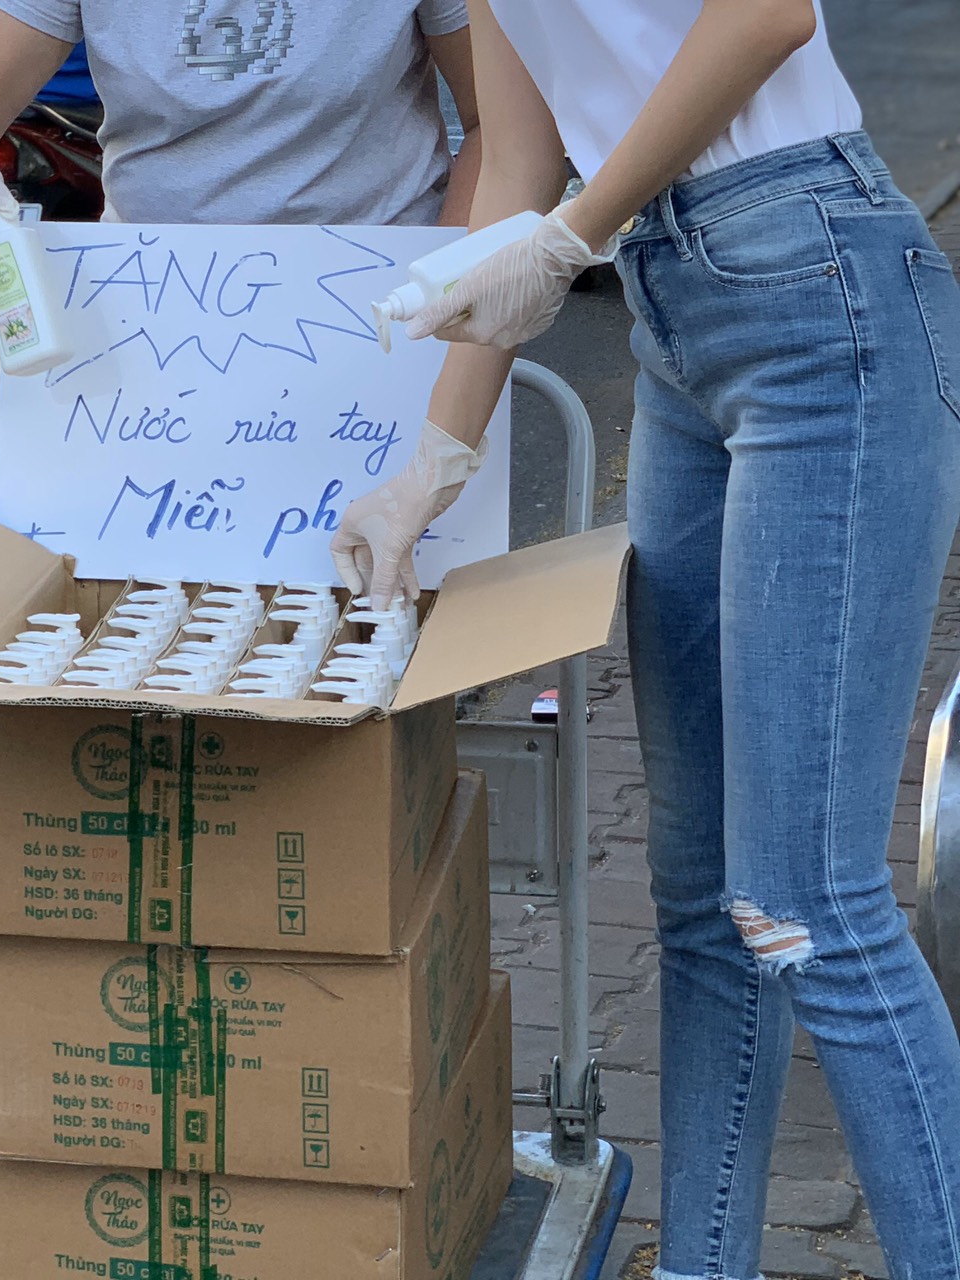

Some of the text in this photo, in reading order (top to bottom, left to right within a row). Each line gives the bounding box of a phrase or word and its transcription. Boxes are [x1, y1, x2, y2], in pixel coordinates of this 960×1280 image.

[329, 401, 403, 477] tay
[262, 478, 354, 559] ph
[23, 812, 78, 832] Thùng
[88, 816, 108, 831] 50
[215, 821, 236, 836] ml
[23, 840, 42, 856] Số
[45, 843, 58, 857] lô
[62, 845, 86, 858] SX:
[23, 865, 58, 882] Ngày
[62, 867, 86, 880] SX:
[24, 886, 123, 905] HSD: 36 tháng
[24, 905, 98, 920] Người ĐG:
[261, 1001, 286, 1013] TAY
[52, 1041, 106, 1063] Thùng
[116, 1046, 135, 1061] 50
[241, 1055, 262, 1070] ml
[52, 1070, 70, 1085] Số
[74, 1074, 87, 1086] lô
[90, 1074, 114, 1088] SX:
[52, 1094, 87, 1110] Ngày
[90, 1096, 114, 1110] SX:
[53, 1114, 87, 1128] HSD:
[110, 1118, 150, 1135] tháng
[53, 1132, 96, 1148] Người
[99, 1135, 126, 1149] ĐG:
[241, 1222, 265, 1235] TAY
[54, 1253, 107, 1276] Thùng
[116, 1261, 135, 1276] 50
